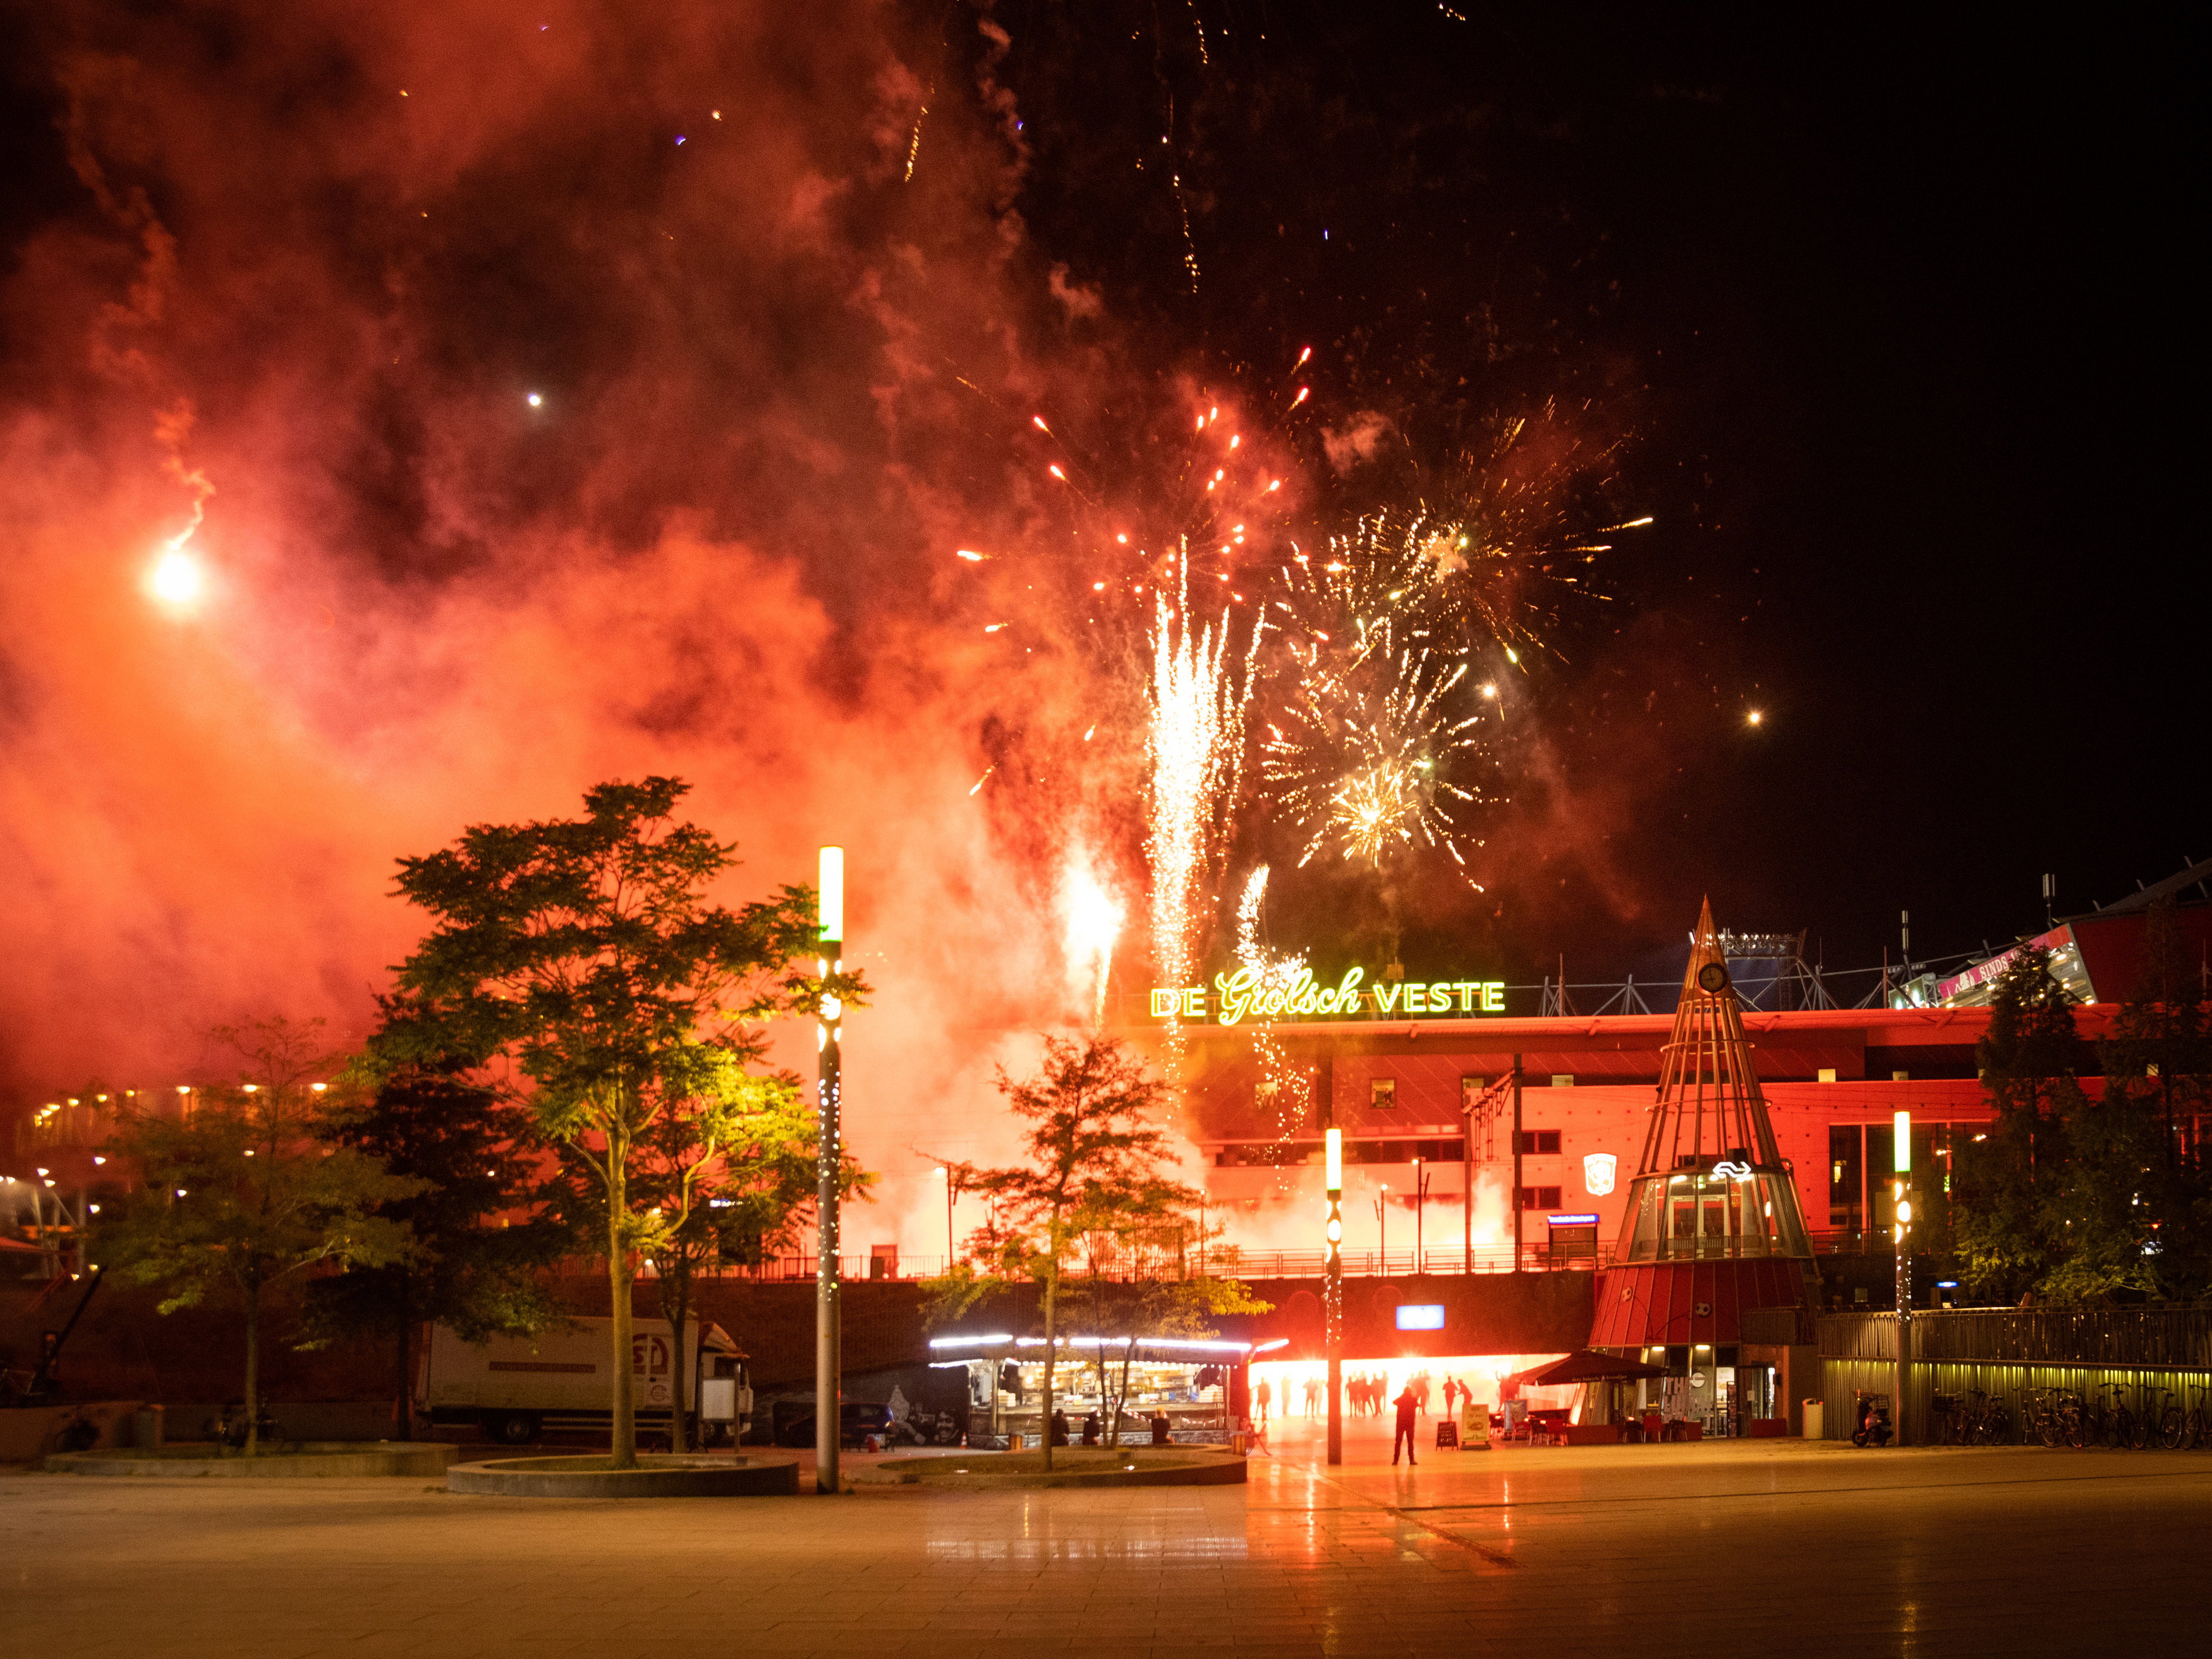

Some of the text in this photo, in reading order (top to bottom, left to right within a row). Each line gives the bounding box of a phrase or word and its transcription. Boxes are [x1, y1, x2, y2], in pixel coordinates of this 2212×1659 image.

[1979, 956, 2010, 980] SINDS
[1151, 965, 1505, 1026] DE Grolsch VESTE
